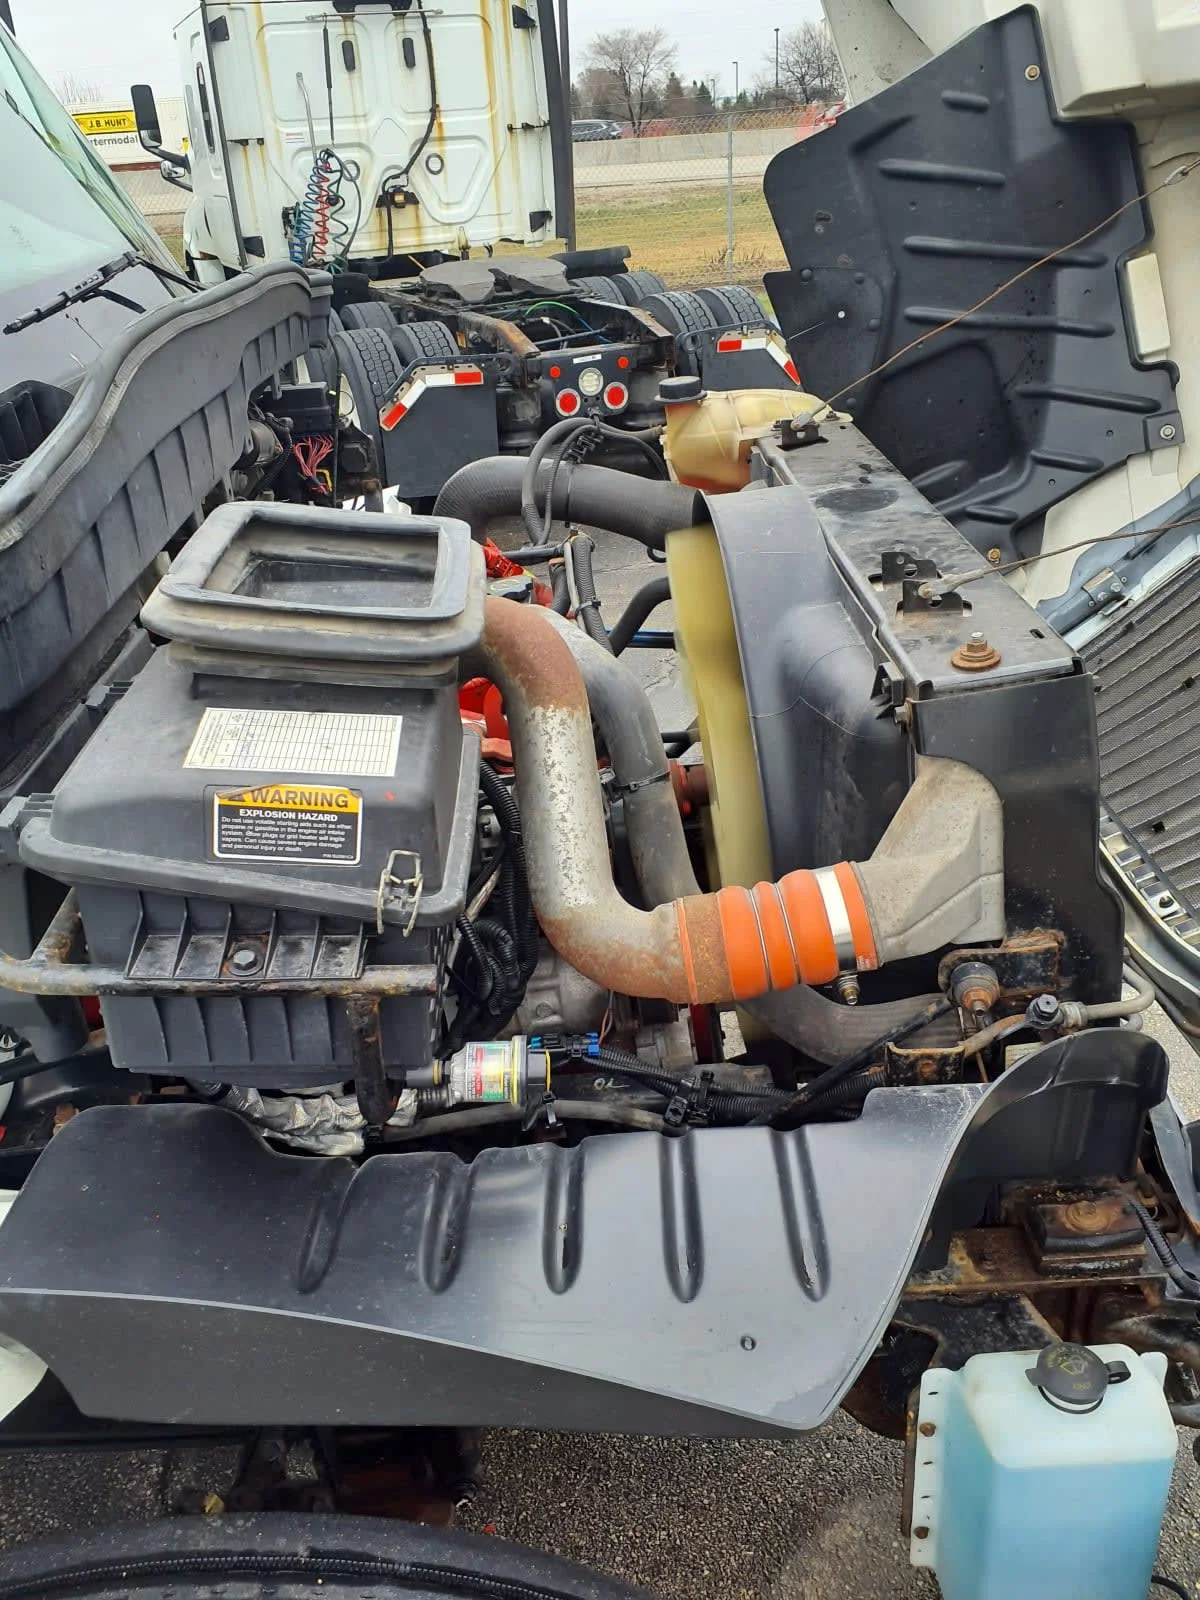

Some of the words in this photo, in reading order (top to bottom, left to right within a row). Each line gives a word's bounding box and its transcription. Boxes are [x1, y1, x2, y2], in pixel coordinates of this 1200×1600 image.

[104, 118, 126, 127] HUNT
[90, 135, 138, 146] termodal
[251, 789, 348, 808] WARNING
[240, 808, 296, 819] EXPLOSION
[298, 812, 338, 822] HAZARD
